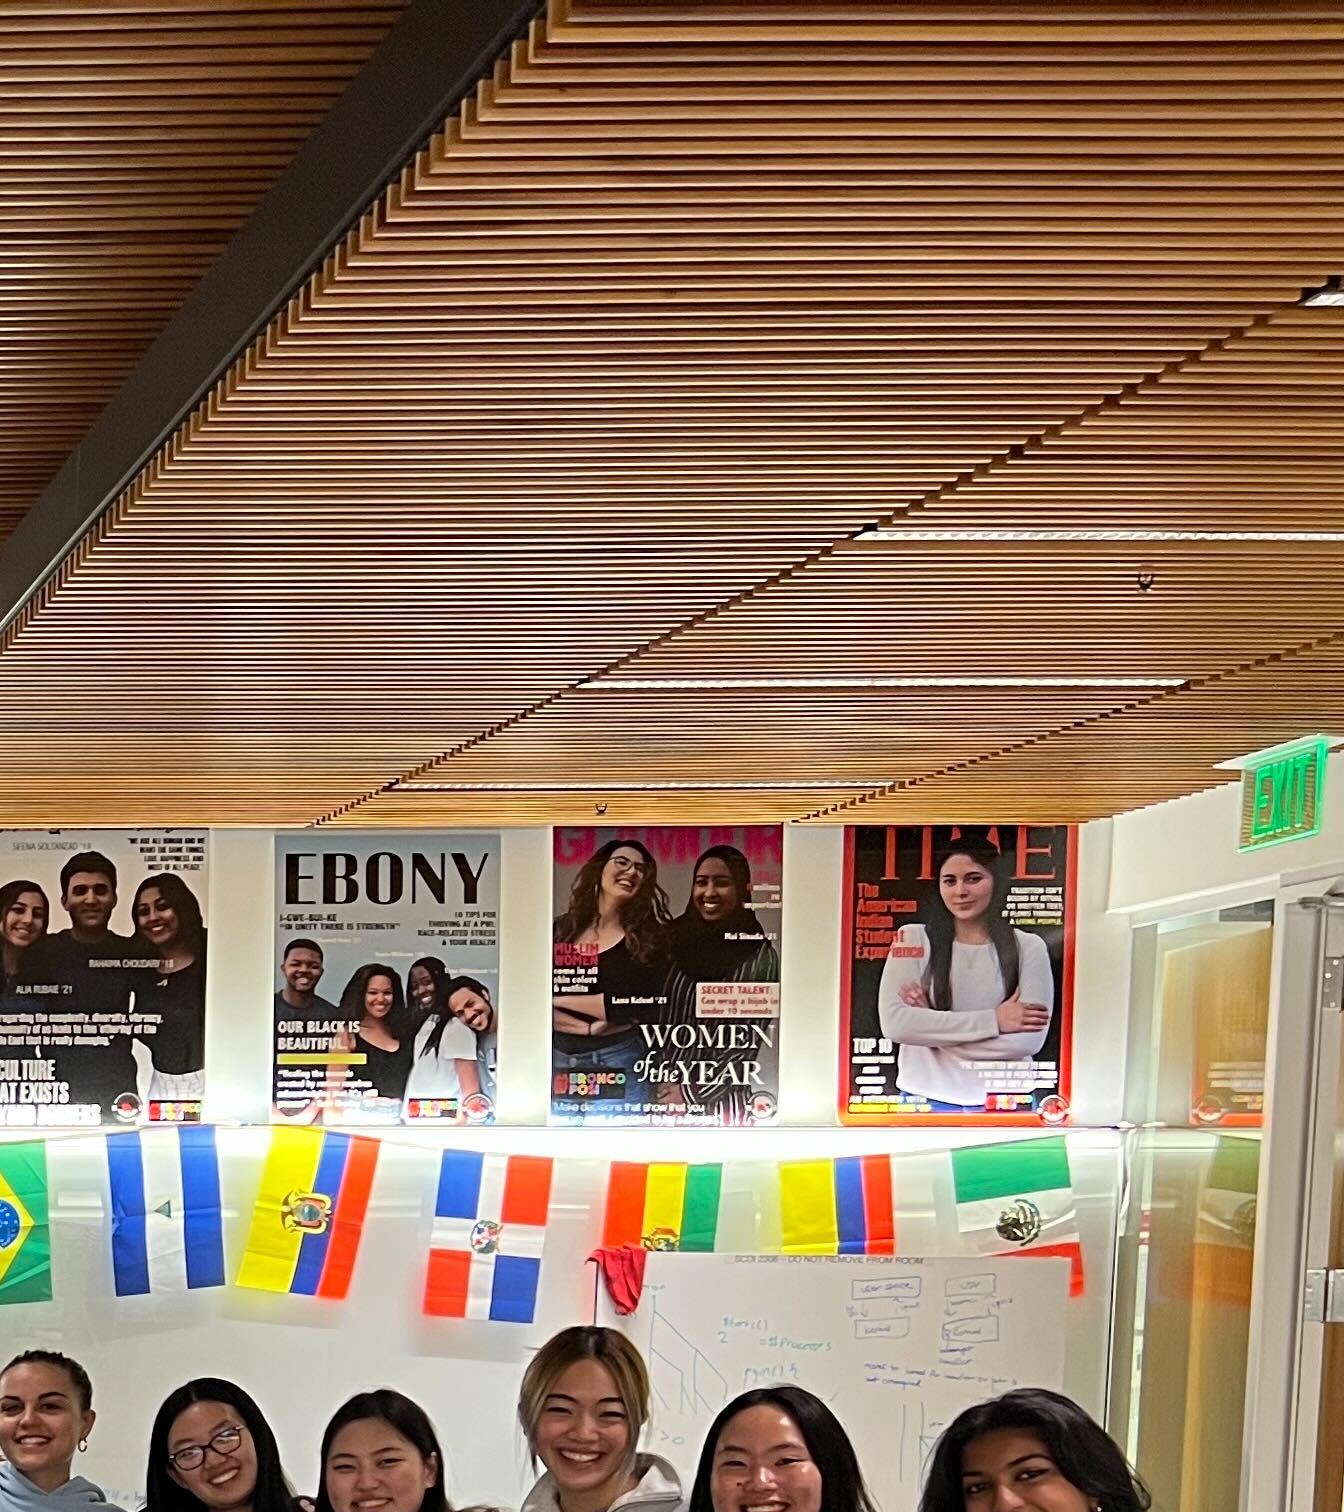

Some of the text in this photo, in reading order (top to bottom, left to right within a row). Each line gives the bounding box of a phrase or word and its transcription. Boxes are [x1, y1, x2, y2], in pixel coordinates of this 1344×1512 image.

[1252, 753, 1312, 838] EXIT
[285, 852, 489, 905] EBONY
[857, 883, 879, 898] The
[857, 899, 917, 912] American
[855, 929, 904, 943] Student
[554, 943, 599, 955] MUSLIM
[554, 955, 598, 966] WOMEN
[278, 1021, 360, 1033] OUR BLACK IS
[640, 1024, 775, 1049] WOMEN
[853, 1038, 877, 1053] TOP
[634, 1051, 765, 1085] of the YEAR
[569, 1073, 627, 1084] BRONCO
[20, 1082, 70, 1103] EXISTS
